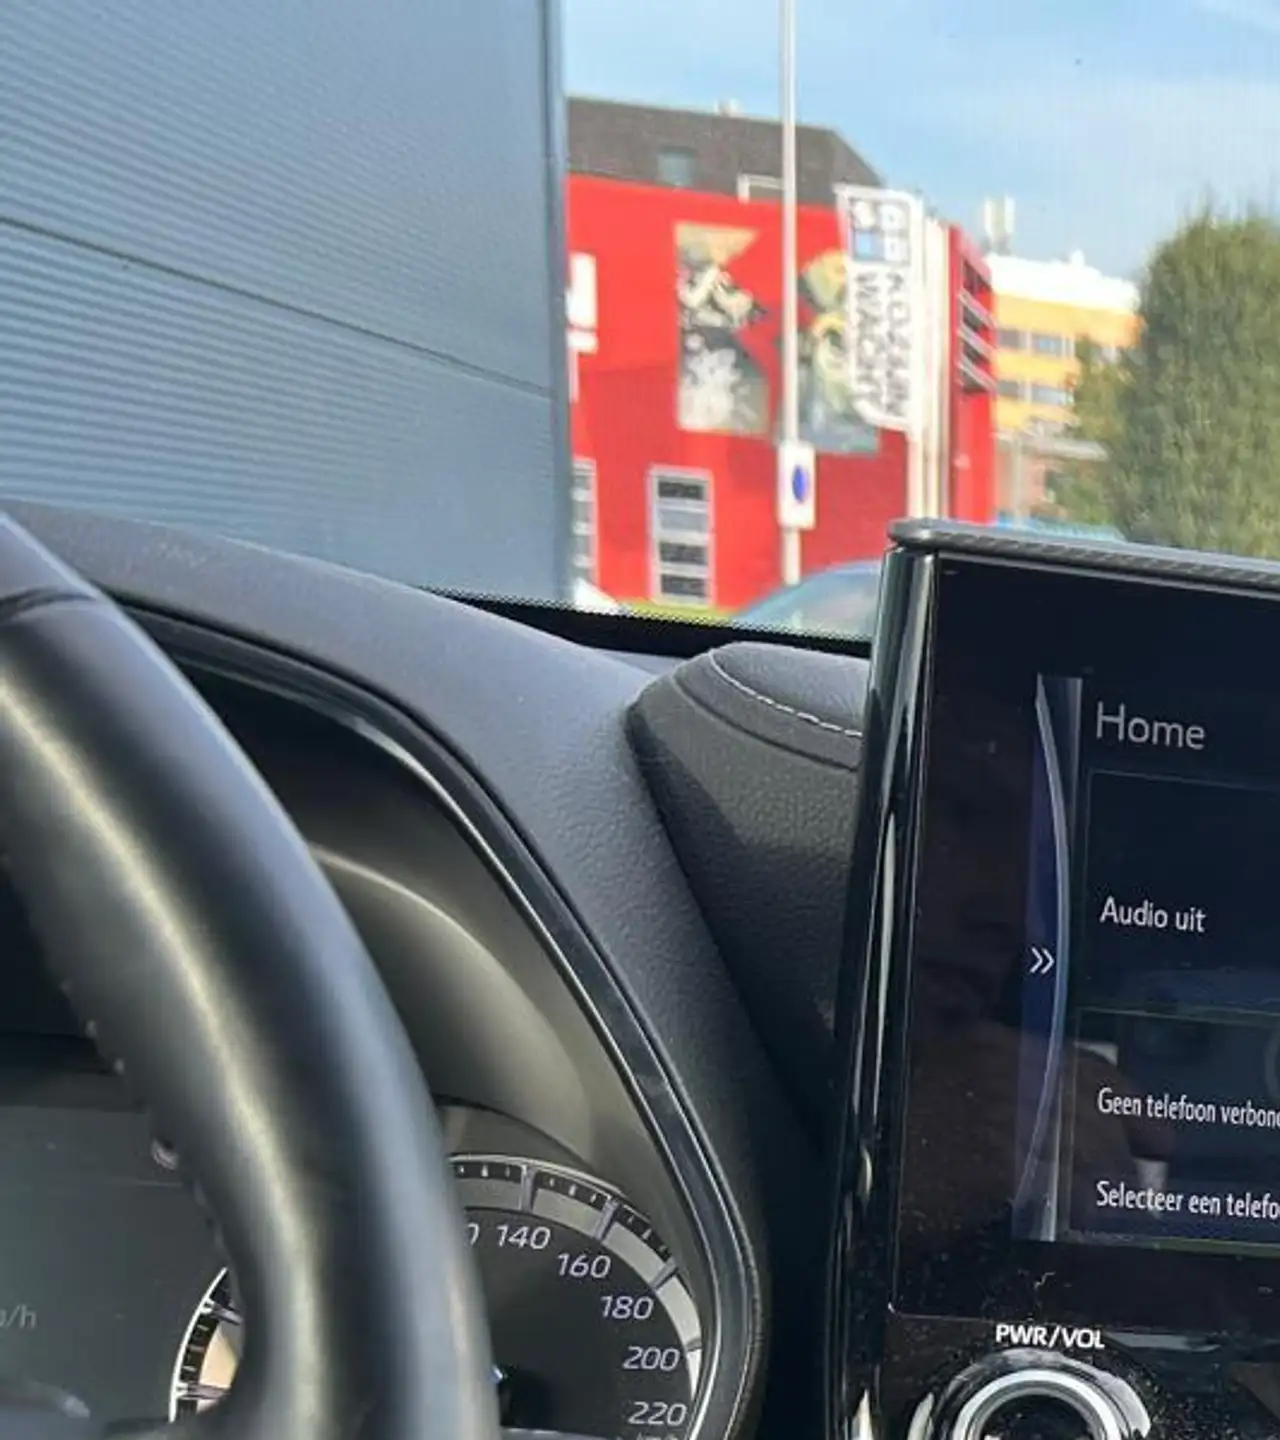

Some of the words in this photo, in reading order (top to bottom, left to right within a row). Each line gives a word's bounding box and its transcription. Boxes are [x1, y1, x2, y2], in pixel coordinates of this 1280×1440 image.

[1096, 701, 1206, 750] Home
[1100, 896, 1168, 929] Audio
[1174, 905, 1206, 932] uit
[1097, 1087, 1142, 1117] Geen
[1147, 1094, 1216, 1123] telefoon
[1096, 1180, 1184, 1212] Selecteer
[1189, 1194, 1221, 1215] een
[496, 1223, 551, 1250] 140
[556, 1251, 612, 1279] 160
[601, 1295, 656, 1321] 180
[995, 1323, 1106, 1351] PWR/VOL
[621, 1345, 681, 1371] 200
[627, 1400, 689, 1427] 220
